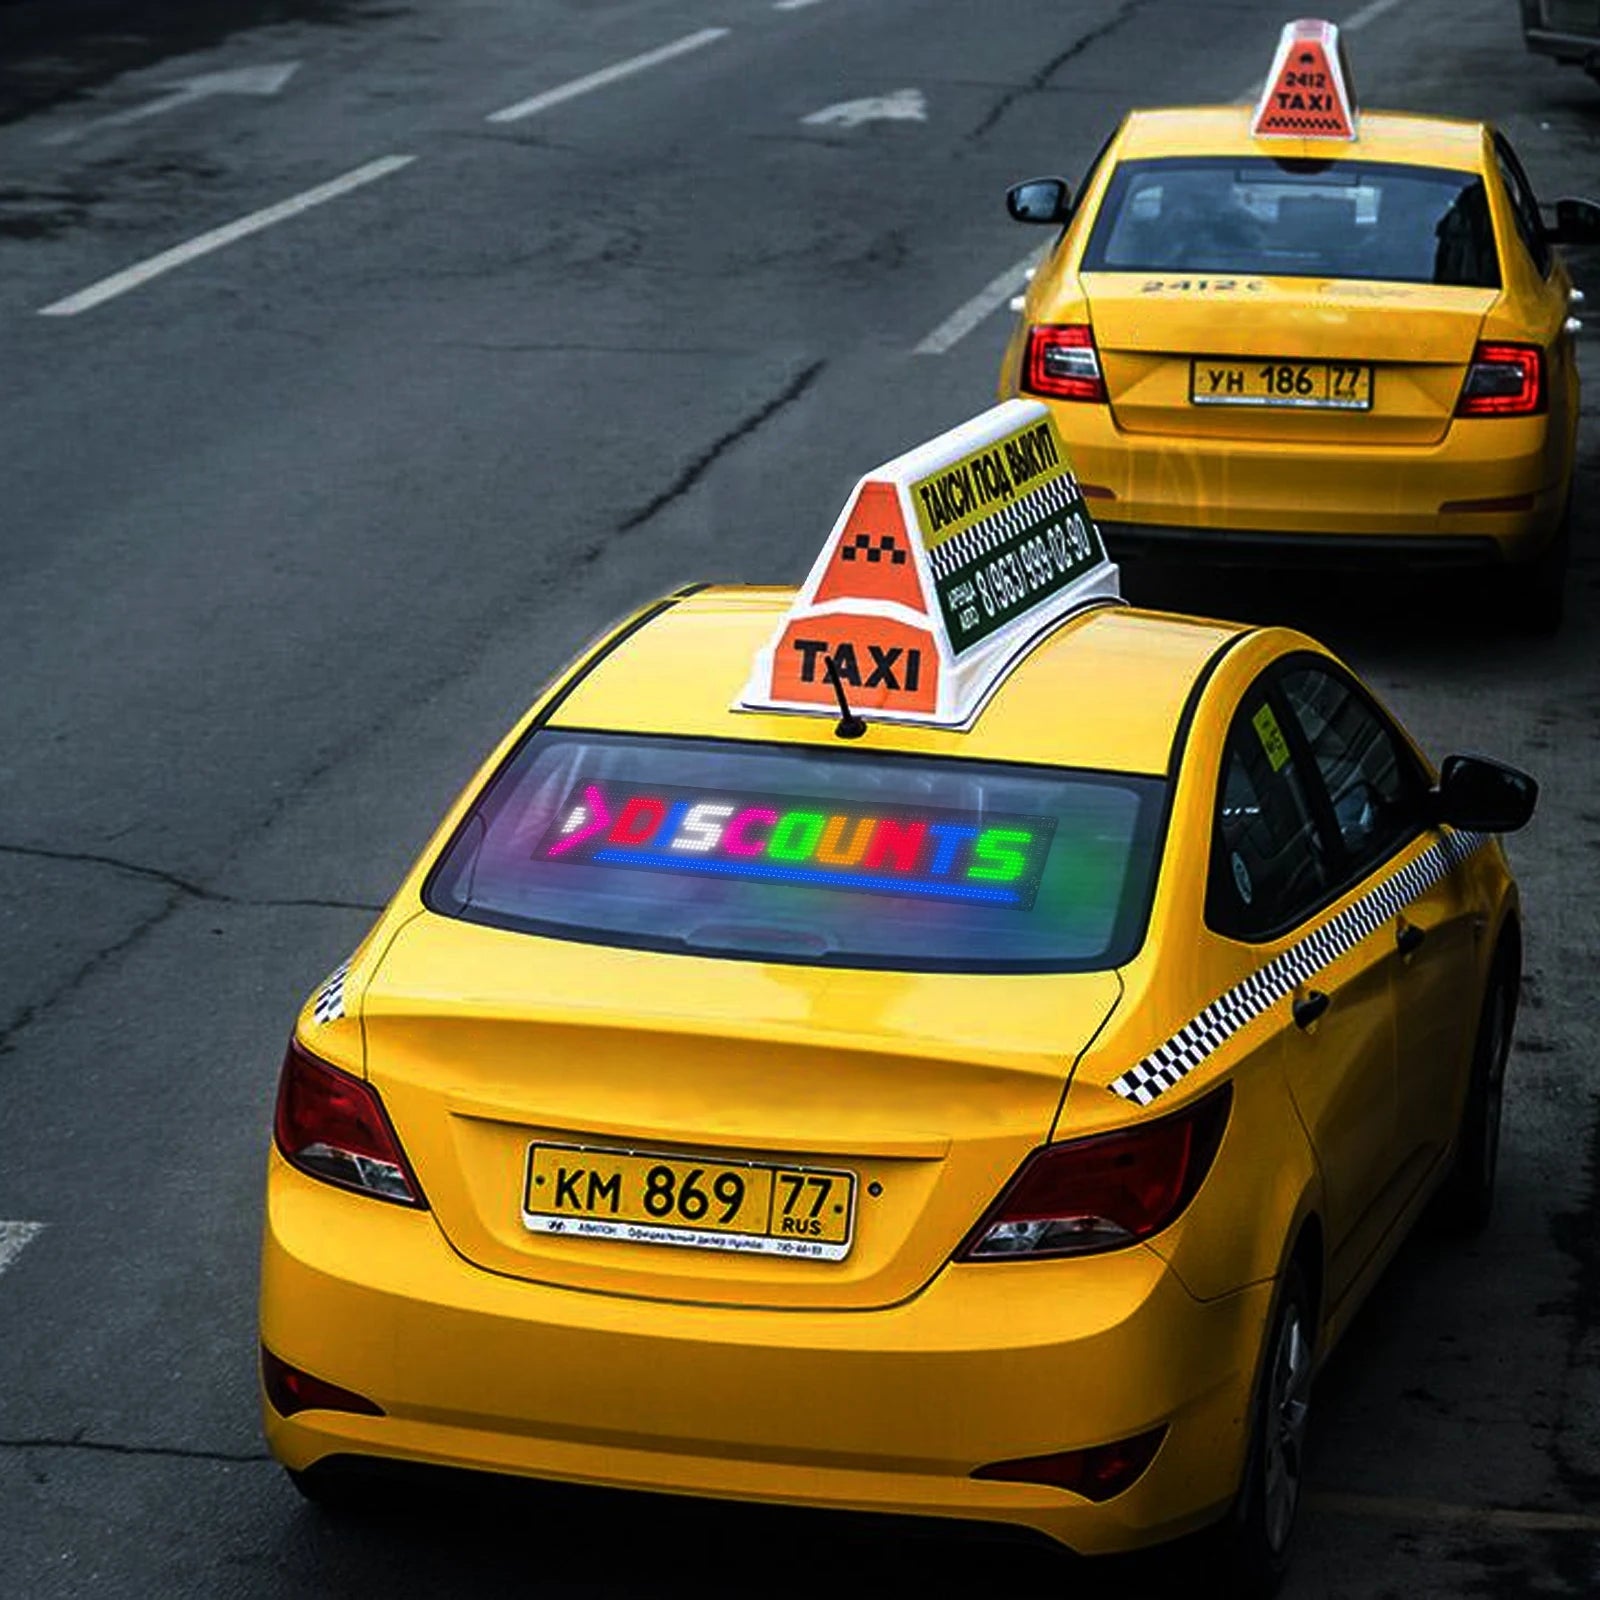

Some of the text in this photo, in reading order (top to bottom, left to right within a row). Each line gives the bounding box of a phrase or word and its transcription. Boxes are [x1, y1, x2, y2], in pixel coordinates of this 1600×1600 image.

[1285, 71, 1325, 89] 2412
[1276, 93, 1333, 111] TAXI
[1259, 366, 1314, 394] 186
[1332, 366, 1361, 391] 77
[920, 422, 1060, 532] ТАКСИ ПОД ВЫКУП
[793, 638, 921, 692] TAXI
[608, 796, 1034, 883] DISCOUNTS
[643, 1165, 746, 1224] 869
[779, 1174, 832, 1218] 77
[781, 1216, 822, 1236] RUS
